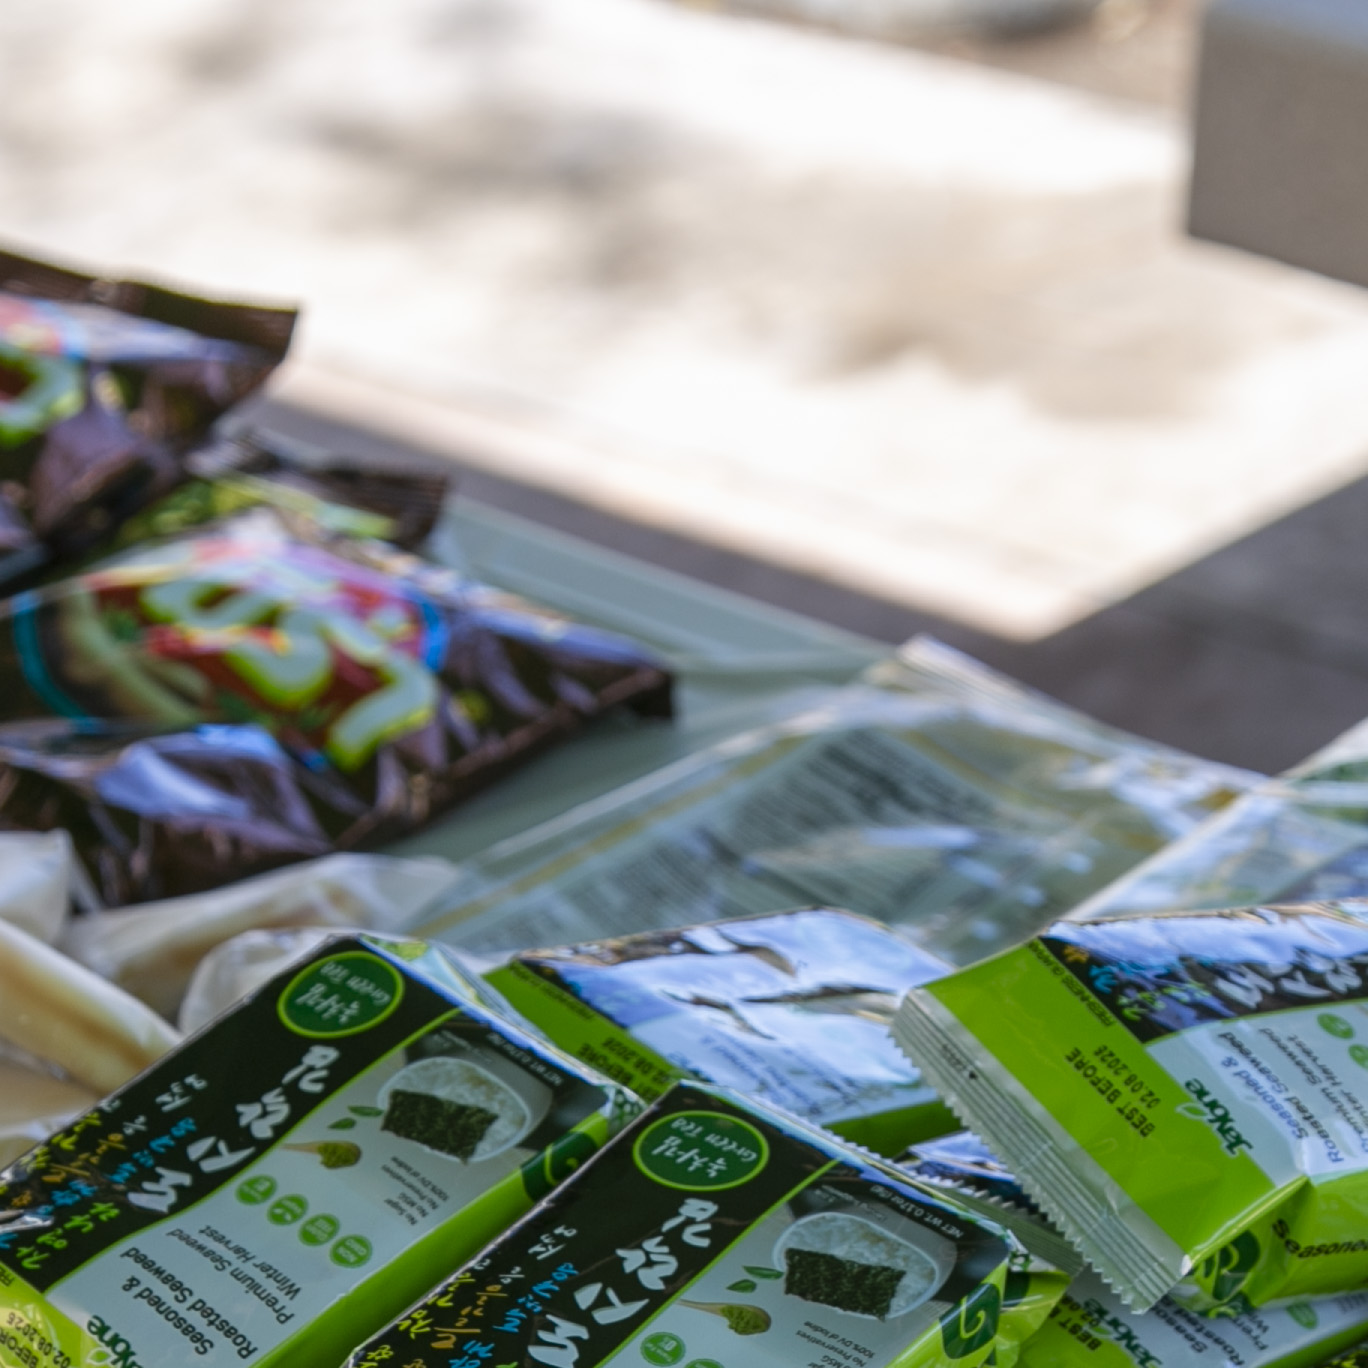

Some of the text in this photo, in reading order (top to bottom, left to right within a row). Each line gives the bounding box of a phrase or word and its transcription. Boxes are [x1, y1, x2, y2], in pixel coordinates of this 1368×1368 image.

[650, 1131, 733, 1183] 녹차김
[669, 1115, 760, 1164] Green Tea
[165, 1224, 297, 1325] Premium Seaweed
[196, 1222, 306, 1300] Winter Harvest
[116, 1245, 262, 1360] Roasted Seaweed
[127, 1286, 221, 1356] Seasoned
[794, 1326, 867, 1367] No Preservatives
[820, 1353, 843, 1368] MSG
